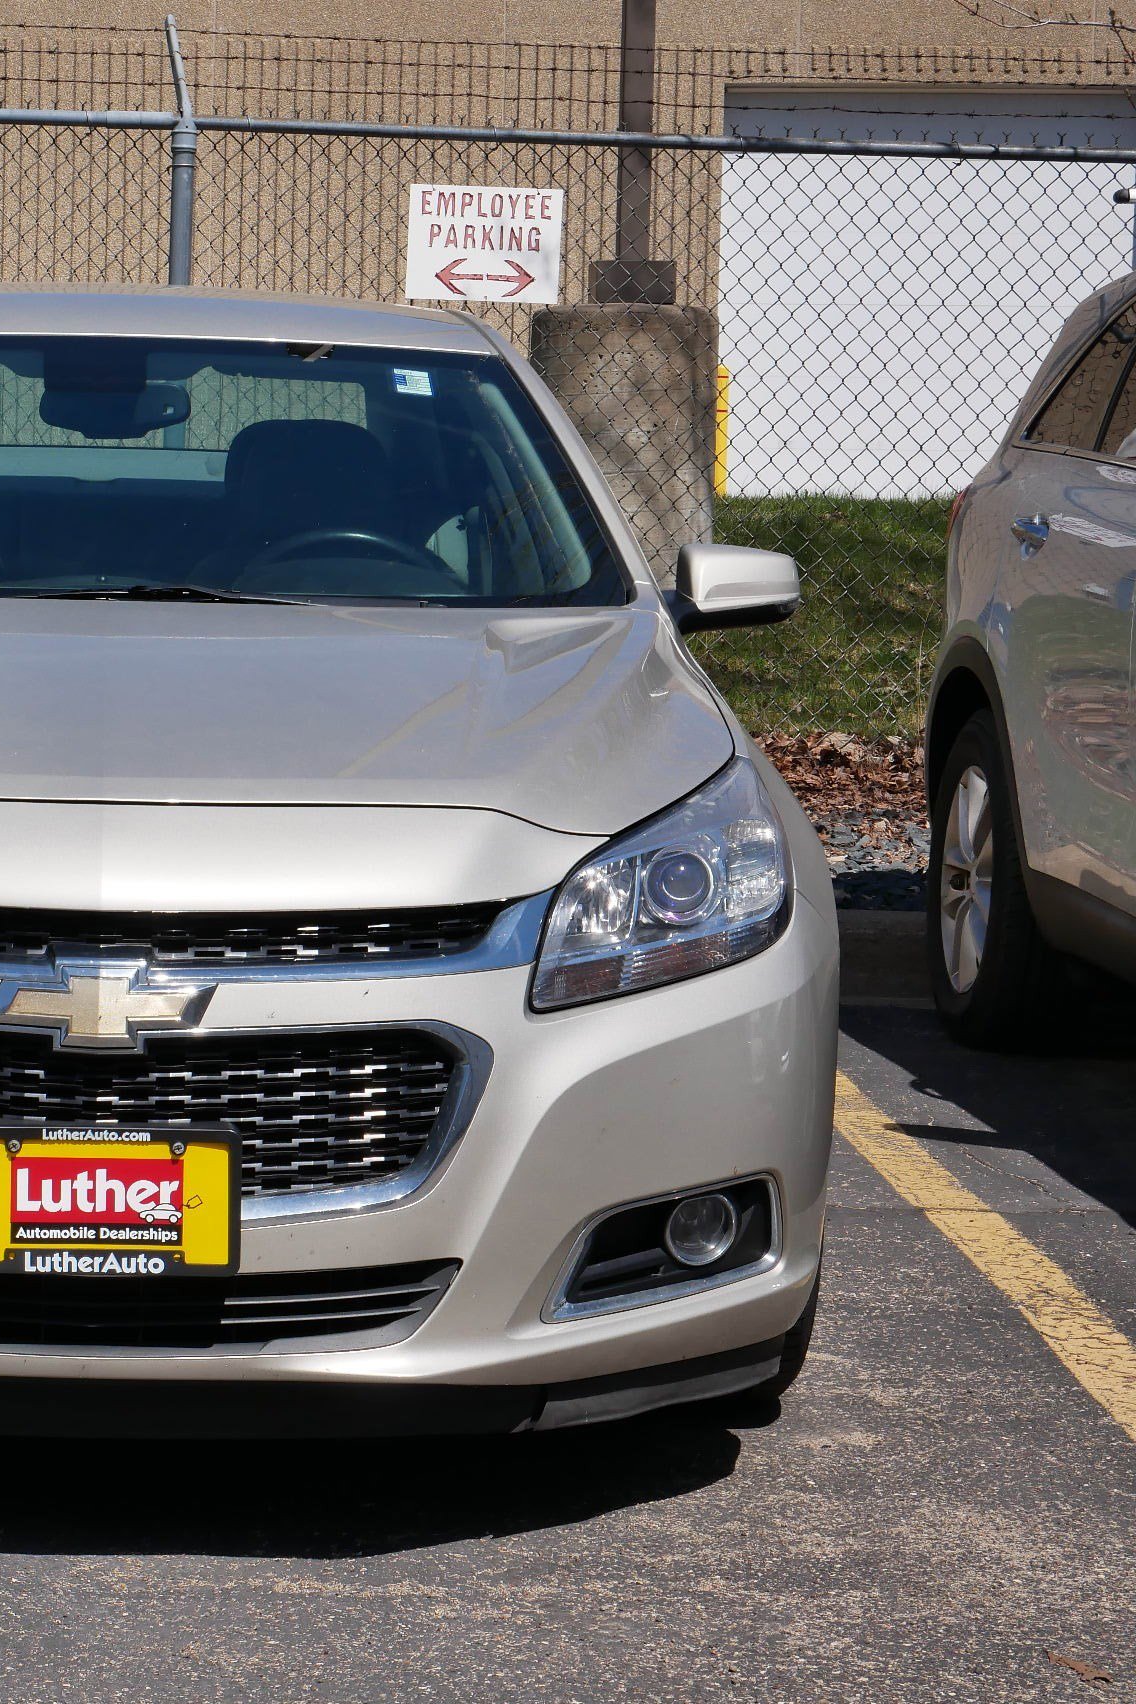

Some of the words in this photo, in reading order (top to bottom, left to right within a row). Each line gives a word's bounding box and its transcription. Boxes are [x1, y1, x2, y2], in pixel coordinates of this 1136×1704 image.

[421, 190, 552, 220] EMPLOYEE
[428, 223, 541, 252] PARKING
[42, 1128, 151, 1142] LutherAuto.com
[16, 1167, 180, 1214] Luther
[15, 1226, 96, 1240] Automobile
[99, 1227, 178, 1243] Dealerships
[24, 1251, 165, 1274] LutherAuto
